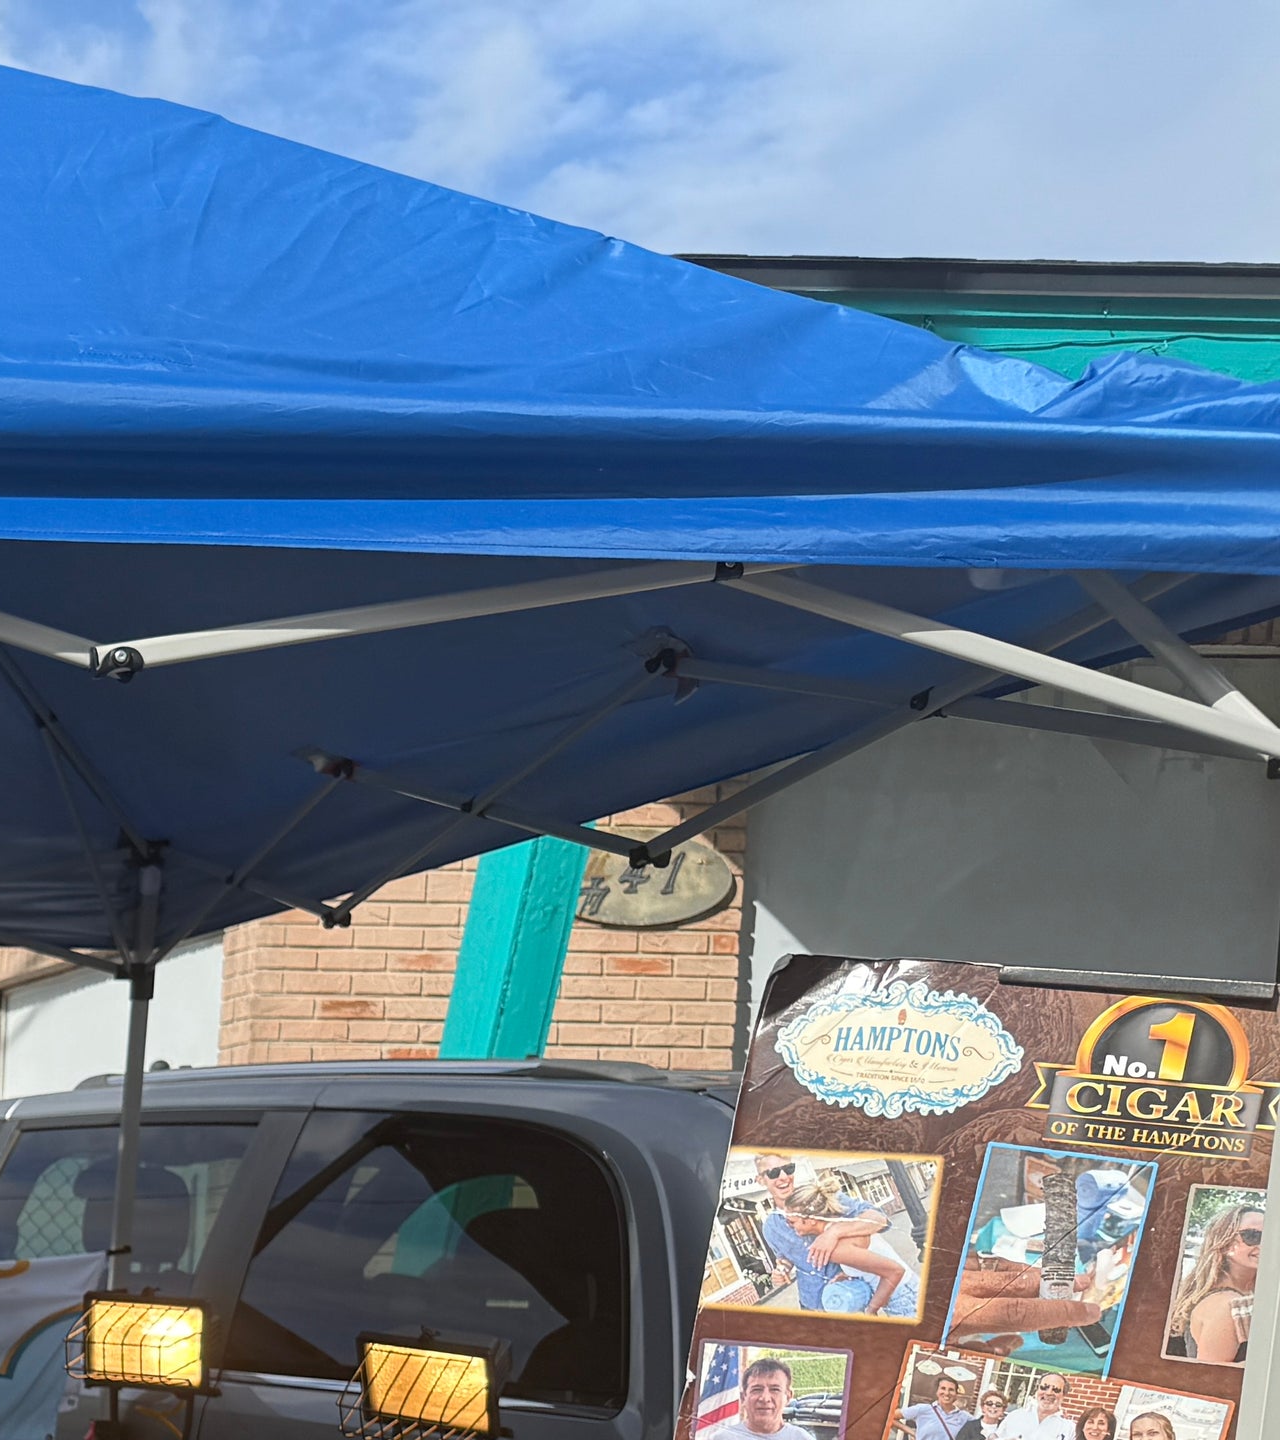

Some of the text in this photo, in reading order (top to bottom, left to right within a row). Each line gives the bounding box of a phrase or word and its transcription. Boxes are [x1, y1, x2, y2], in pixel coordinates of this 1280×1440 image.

[833, 1026, 961, 1062] HAMPTONS
[856, 1072, 890, 1082] TRADITION
[1066, 1081, 1247, 1129] CIGAR
[1050, 1120, 1246, 1153] OF THE HAMPTONS
